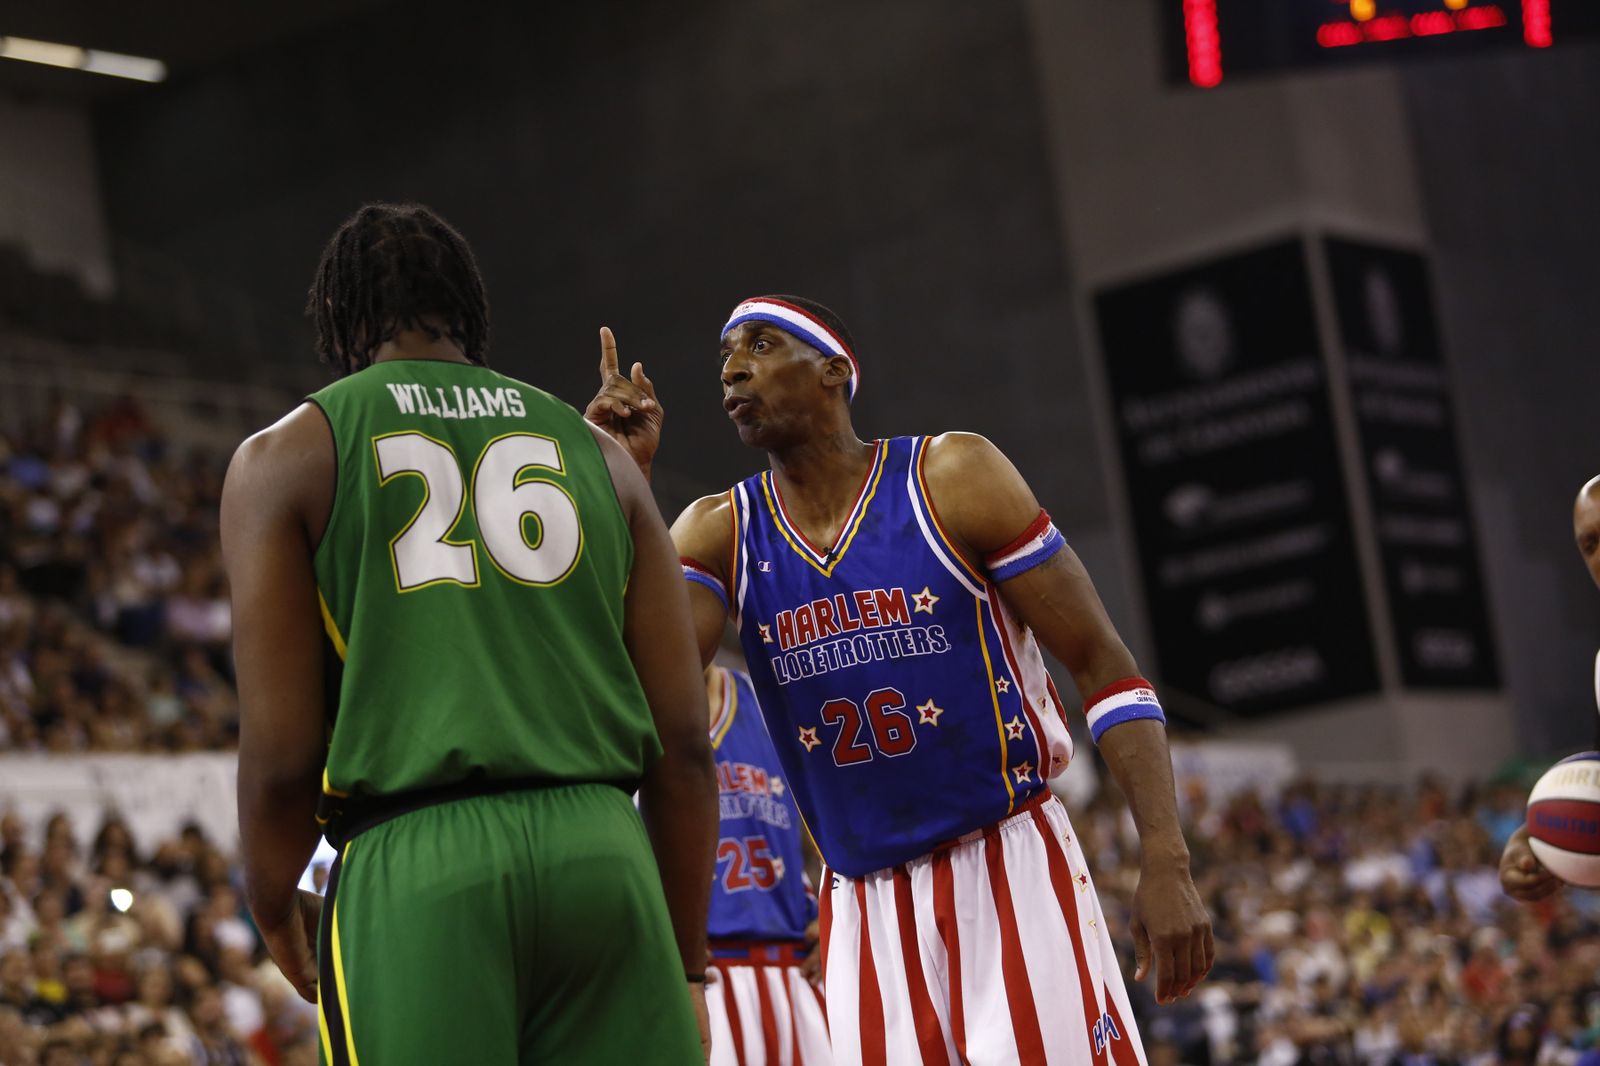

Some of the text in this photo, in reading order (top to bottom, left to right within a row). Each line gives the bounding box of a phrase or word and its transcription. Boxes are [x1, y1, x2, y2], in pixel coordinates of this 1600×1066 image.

[387, 383, 526, 419] WILLIAMS
[371, 429, 584, 593] 26
[776, 587, 911, 652] HARLEM
[771, 625, 948, 685] LOBETROTTERS
[821, 687, 917, 767] 26
[717, 836, 777, 894] 25
